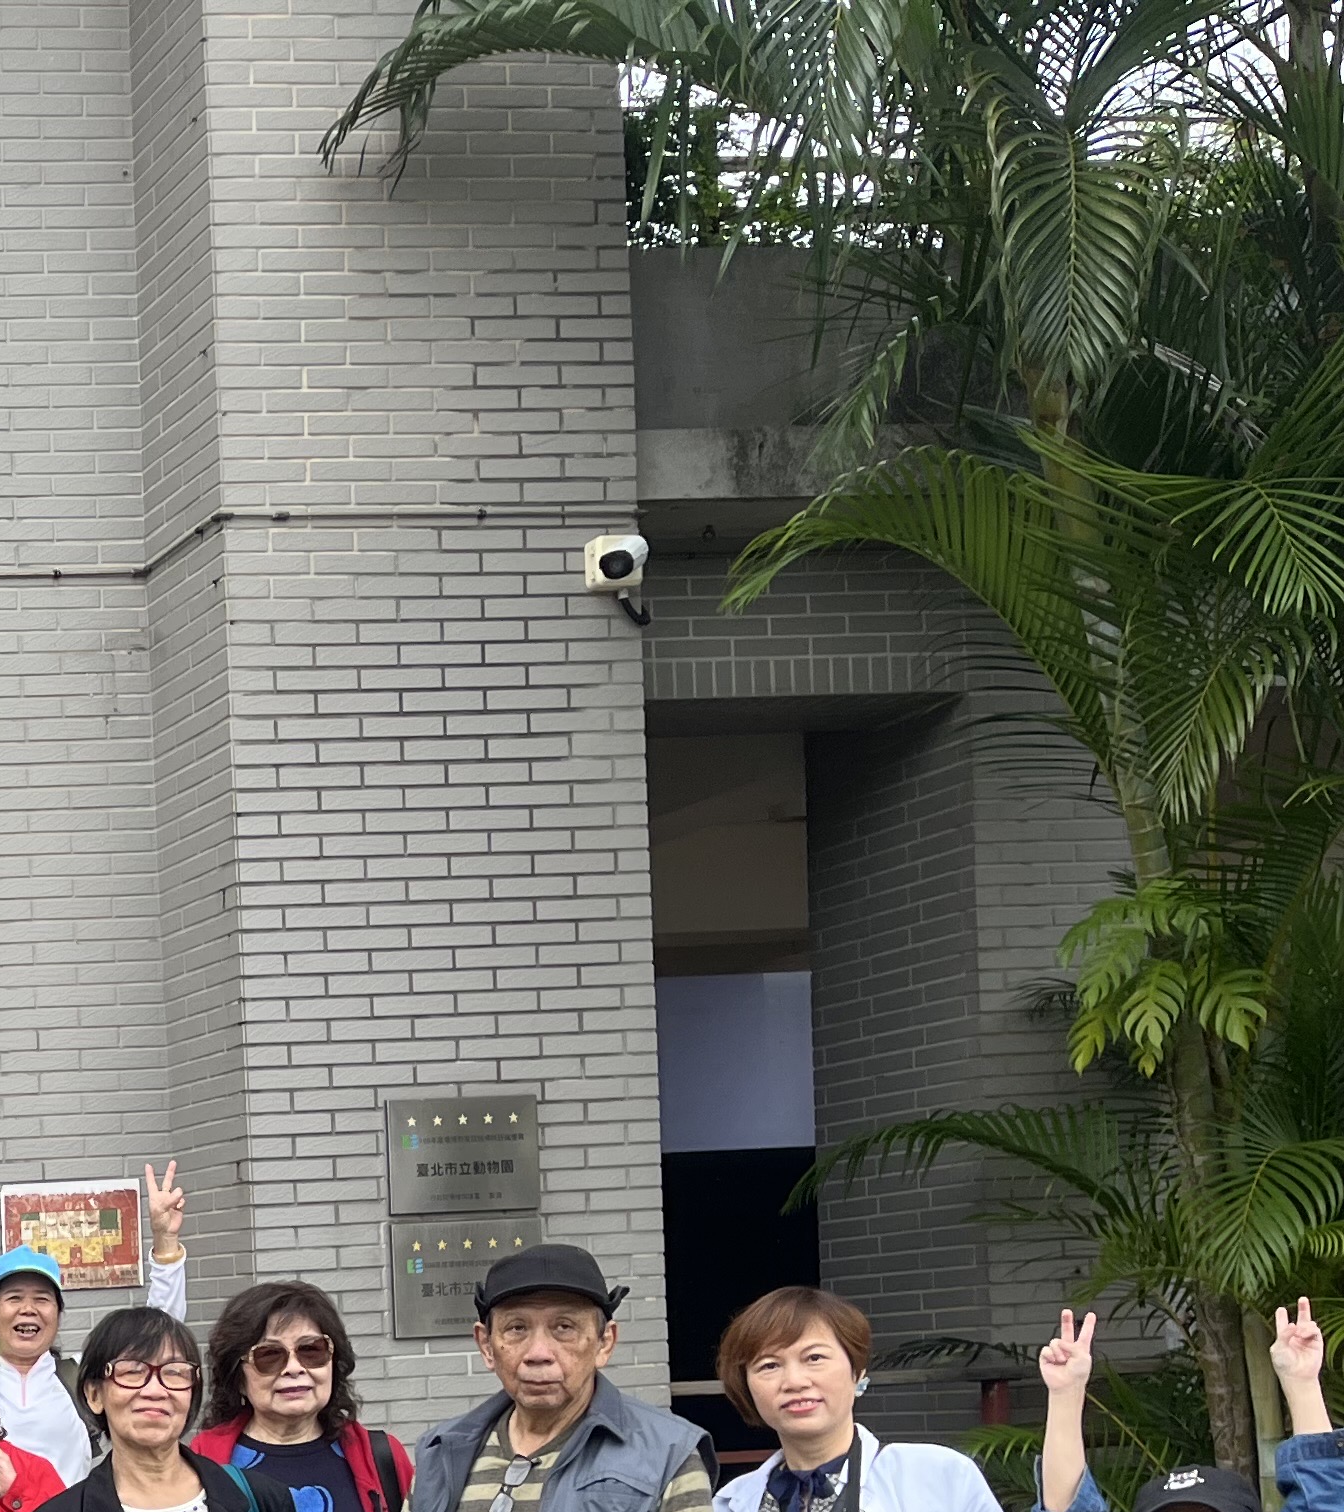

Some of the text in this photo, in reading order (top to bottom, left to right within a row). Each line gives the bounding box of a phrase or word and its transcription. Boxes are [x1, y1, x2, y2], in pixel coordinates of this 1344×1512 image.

[416, 1159, 514, 1177] 臺北市立動物園
